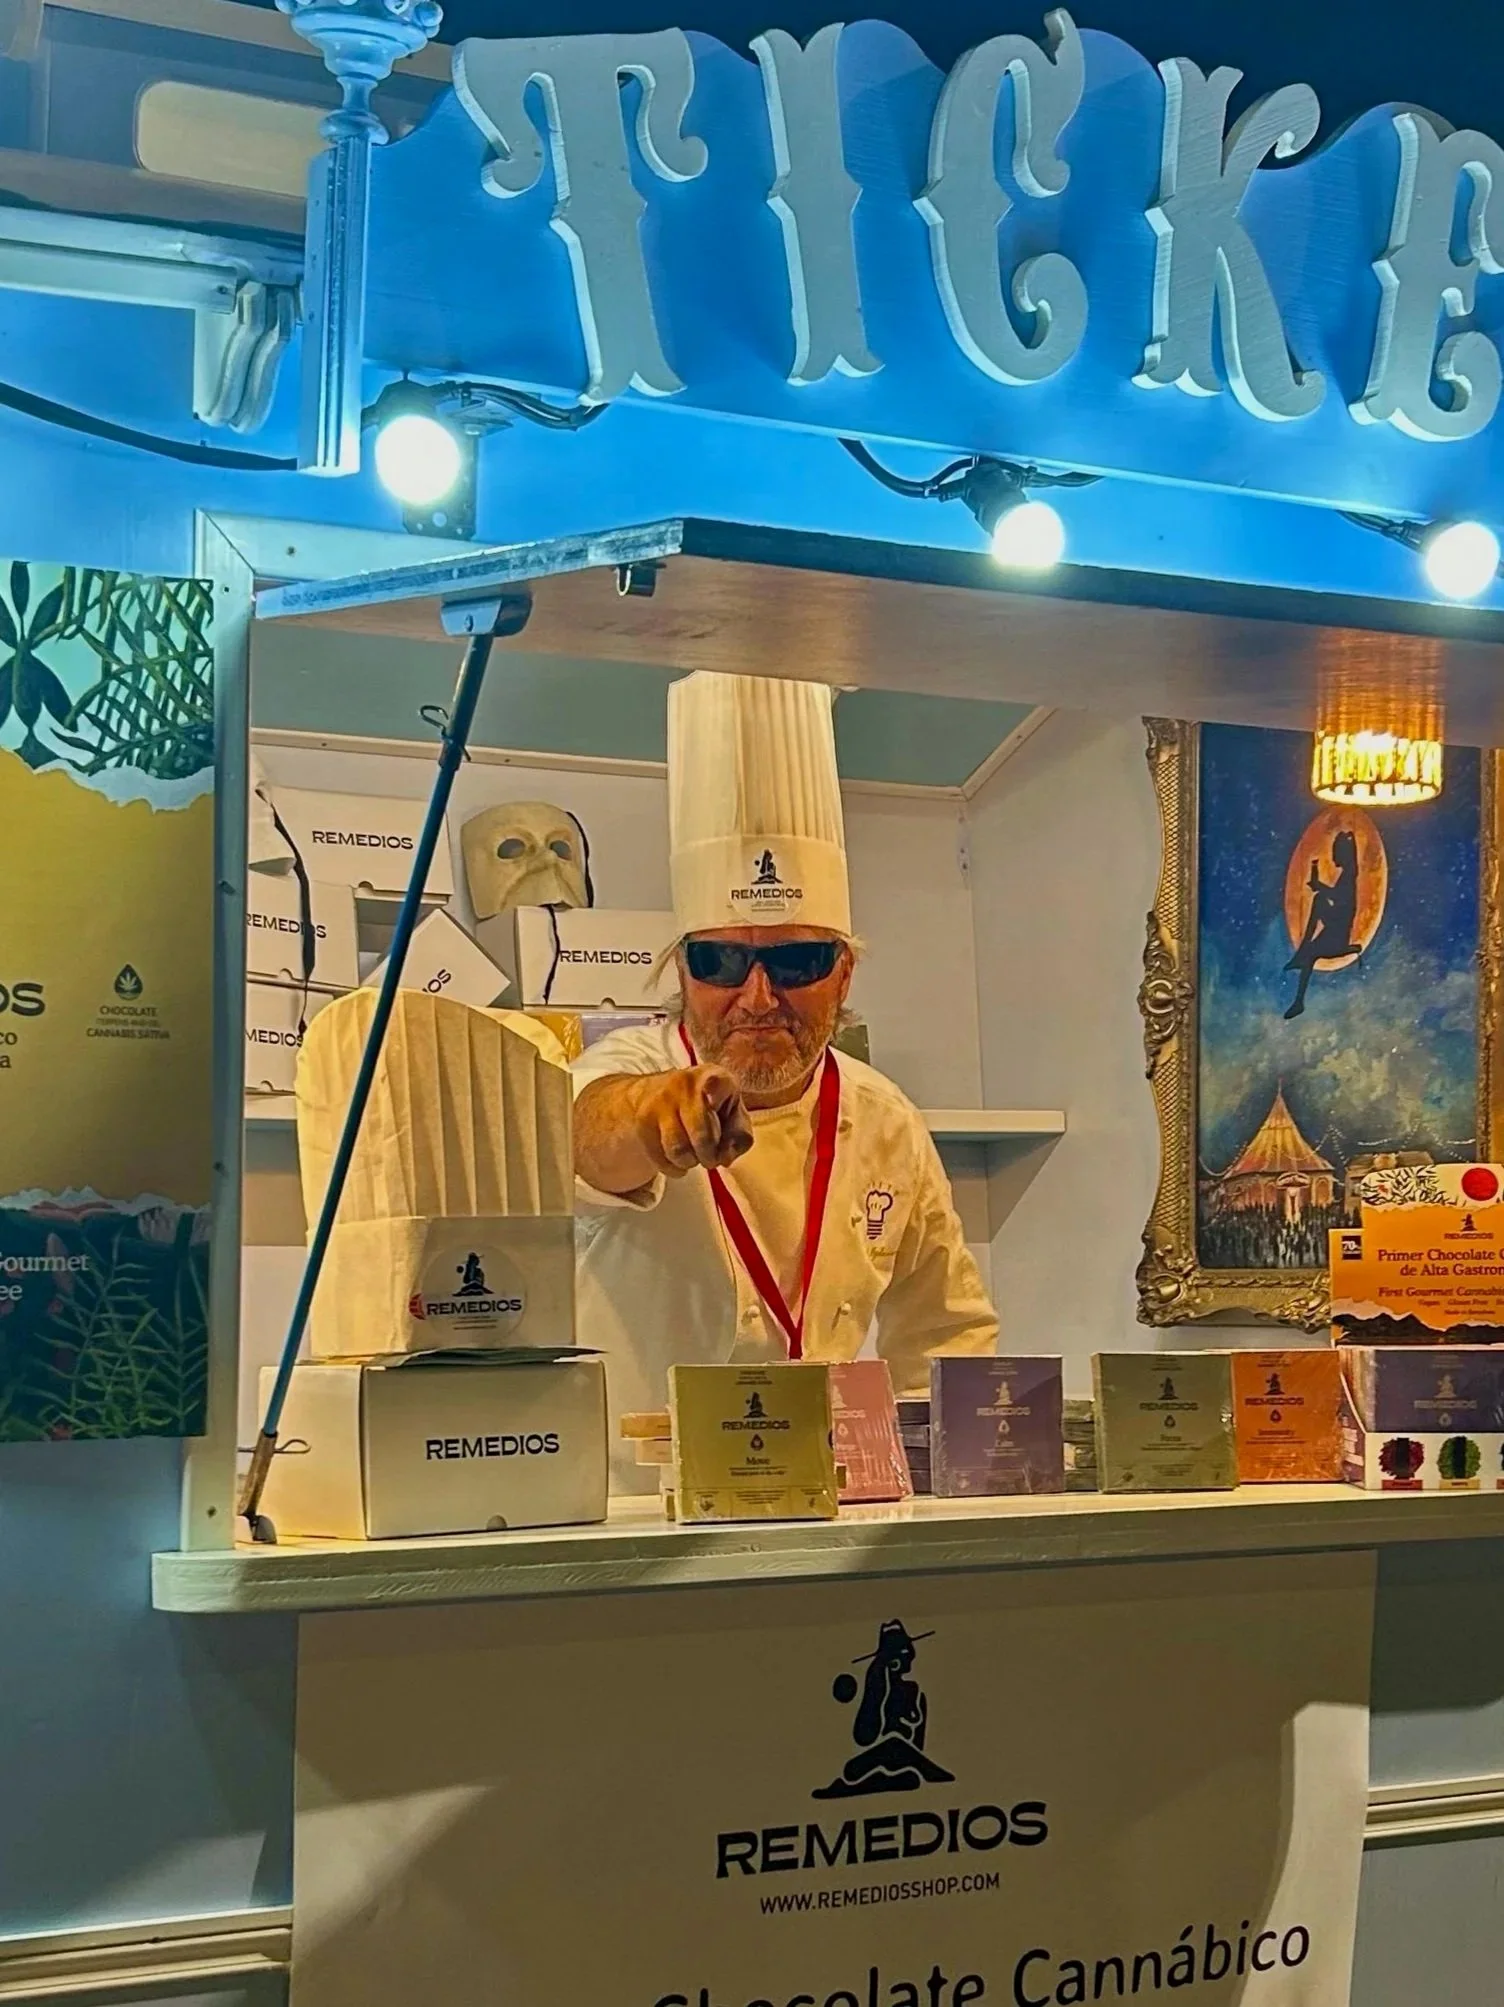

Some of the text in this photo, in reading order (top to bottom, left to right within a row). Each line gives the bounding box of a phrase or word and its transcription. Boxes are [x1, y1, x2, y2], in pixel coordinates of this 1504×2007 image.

[451, 7, 1504, 441] TICKE
[312, 830, 414, 850] REMEDIOS
[730, 888, 804, 900] REMEDIOS
[246, 912, 327, 939] REMEDIS
[560, 950, 653, 964] REMEDIOS
[99, 1005, 158, 1017] CHOCOLATE
[0, 1251, 90, 1272] ourmet
[1377, 1249, 1424, 1261] Primer
[1427, 1248, 1496, 1261] Chocolate
[1400, 1264, 1417, 1276] de
[1420, 1264, 1449, 1276] Alta
[1378, 1286, 1403, 1297] First
[1406, 1286, 1454, 1297] Gourmet
[426, 1299, 523, 1316] REMEDIOS
[721, 1420, 791, 1431] REMEDIOS
[426, 1433, 560, 1460] REMEDIOS
[716, 1801, 1049, 1879] REMEDIOS
[760, 1872, 1000, 1915] WWW.REMEDIOSSHOP.COM
[1013, 1919, 1310, 2007] Cannábico
